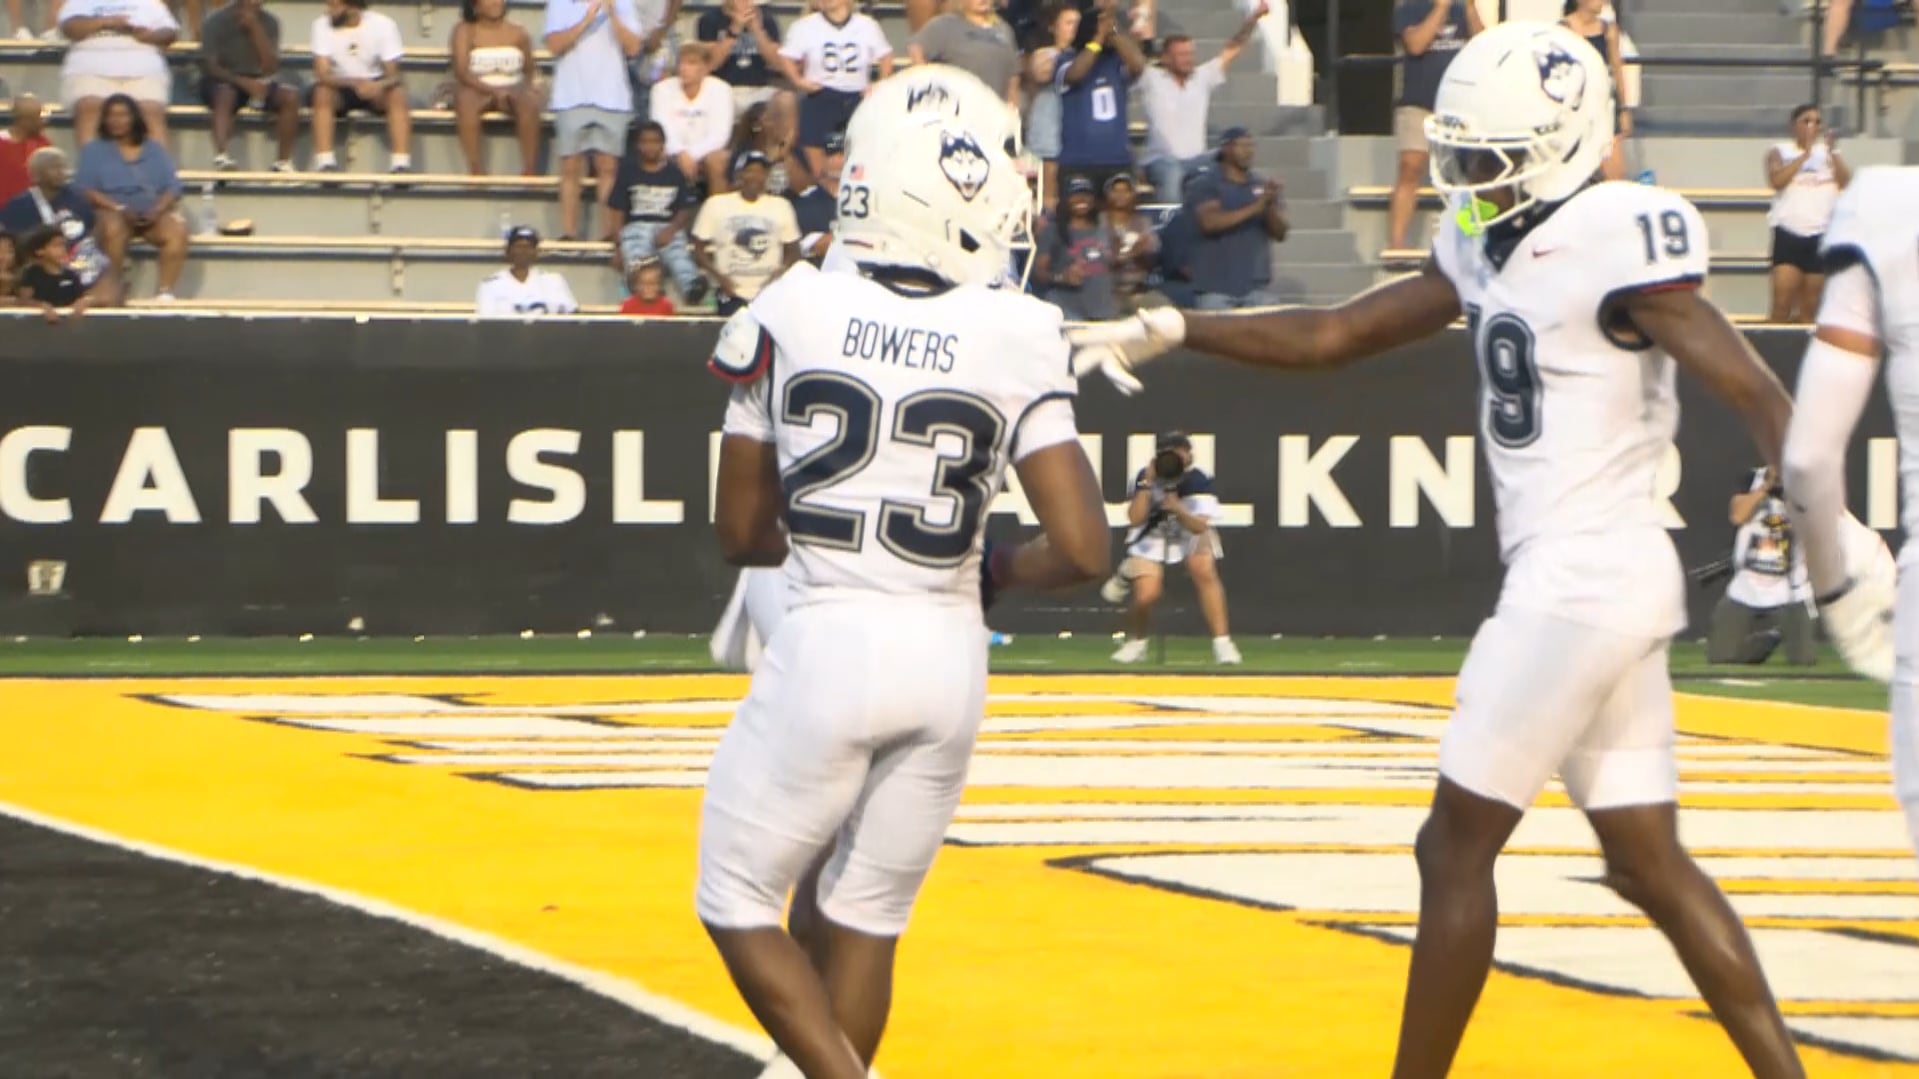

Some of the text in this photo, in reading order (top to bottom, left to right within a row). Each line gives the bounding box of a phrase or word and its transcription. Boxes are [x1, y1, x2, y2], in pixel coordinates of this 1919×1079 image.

[840, 184, 870, 218] 23
[1636, 209, 1690, 262] 19
[842, 317, 960, 373] BOWERS
[0, 425, 724, 524] CARLISL
[781, 368, 1008, 568] 23
